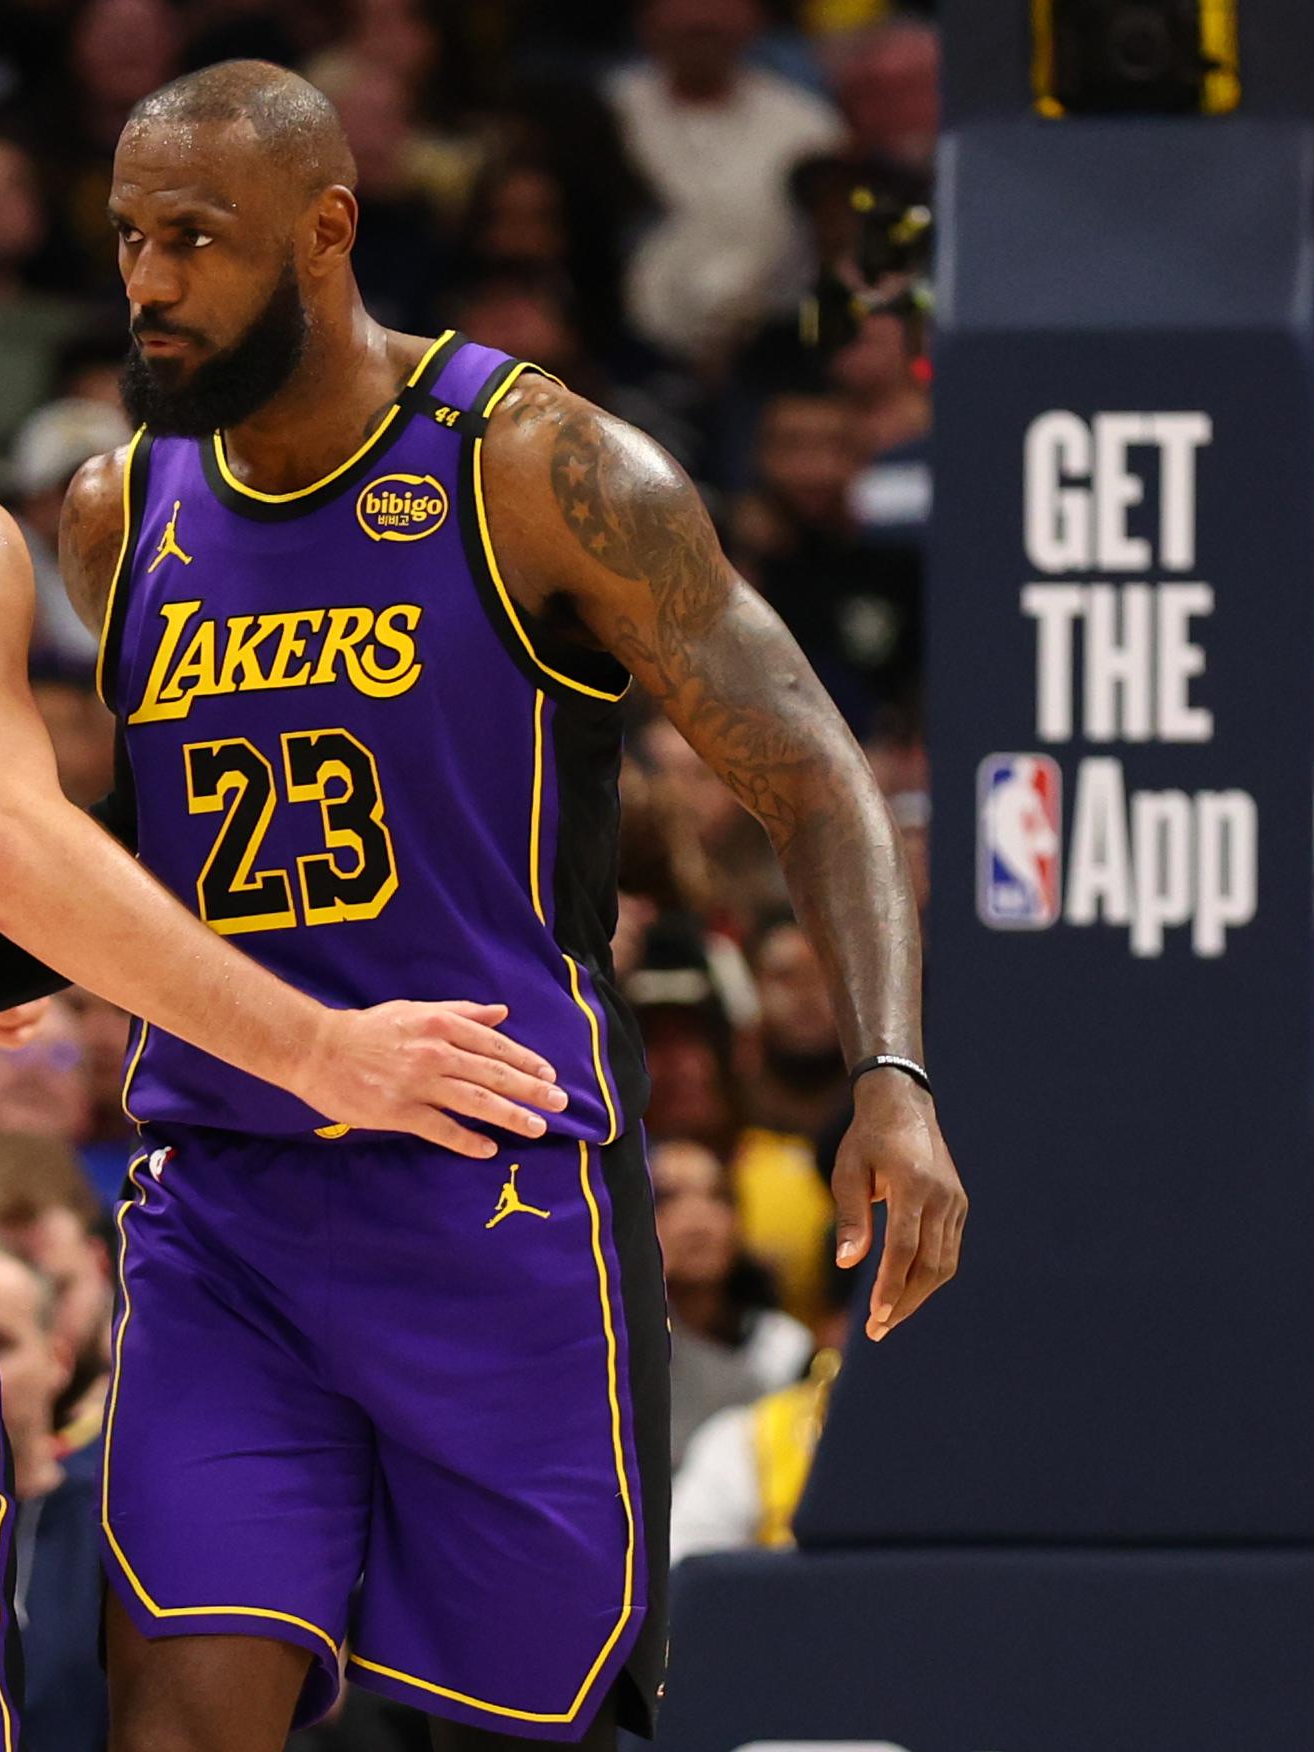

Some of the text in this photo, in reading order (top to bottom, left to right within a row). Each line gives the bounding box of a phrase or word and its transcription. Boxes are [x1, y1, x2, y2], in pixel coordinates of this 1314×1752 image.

[435, 407, 461, 427] 44
[1023, 411, 1212, 572] GET
[366, 491, 442, 521] bibigo
[127, 600, 423, 726] LAKERS
[1021, 583, 1213, 743] THE
[182, 727, 400, 936] 23
[1065, 756, 1258, 957] App
